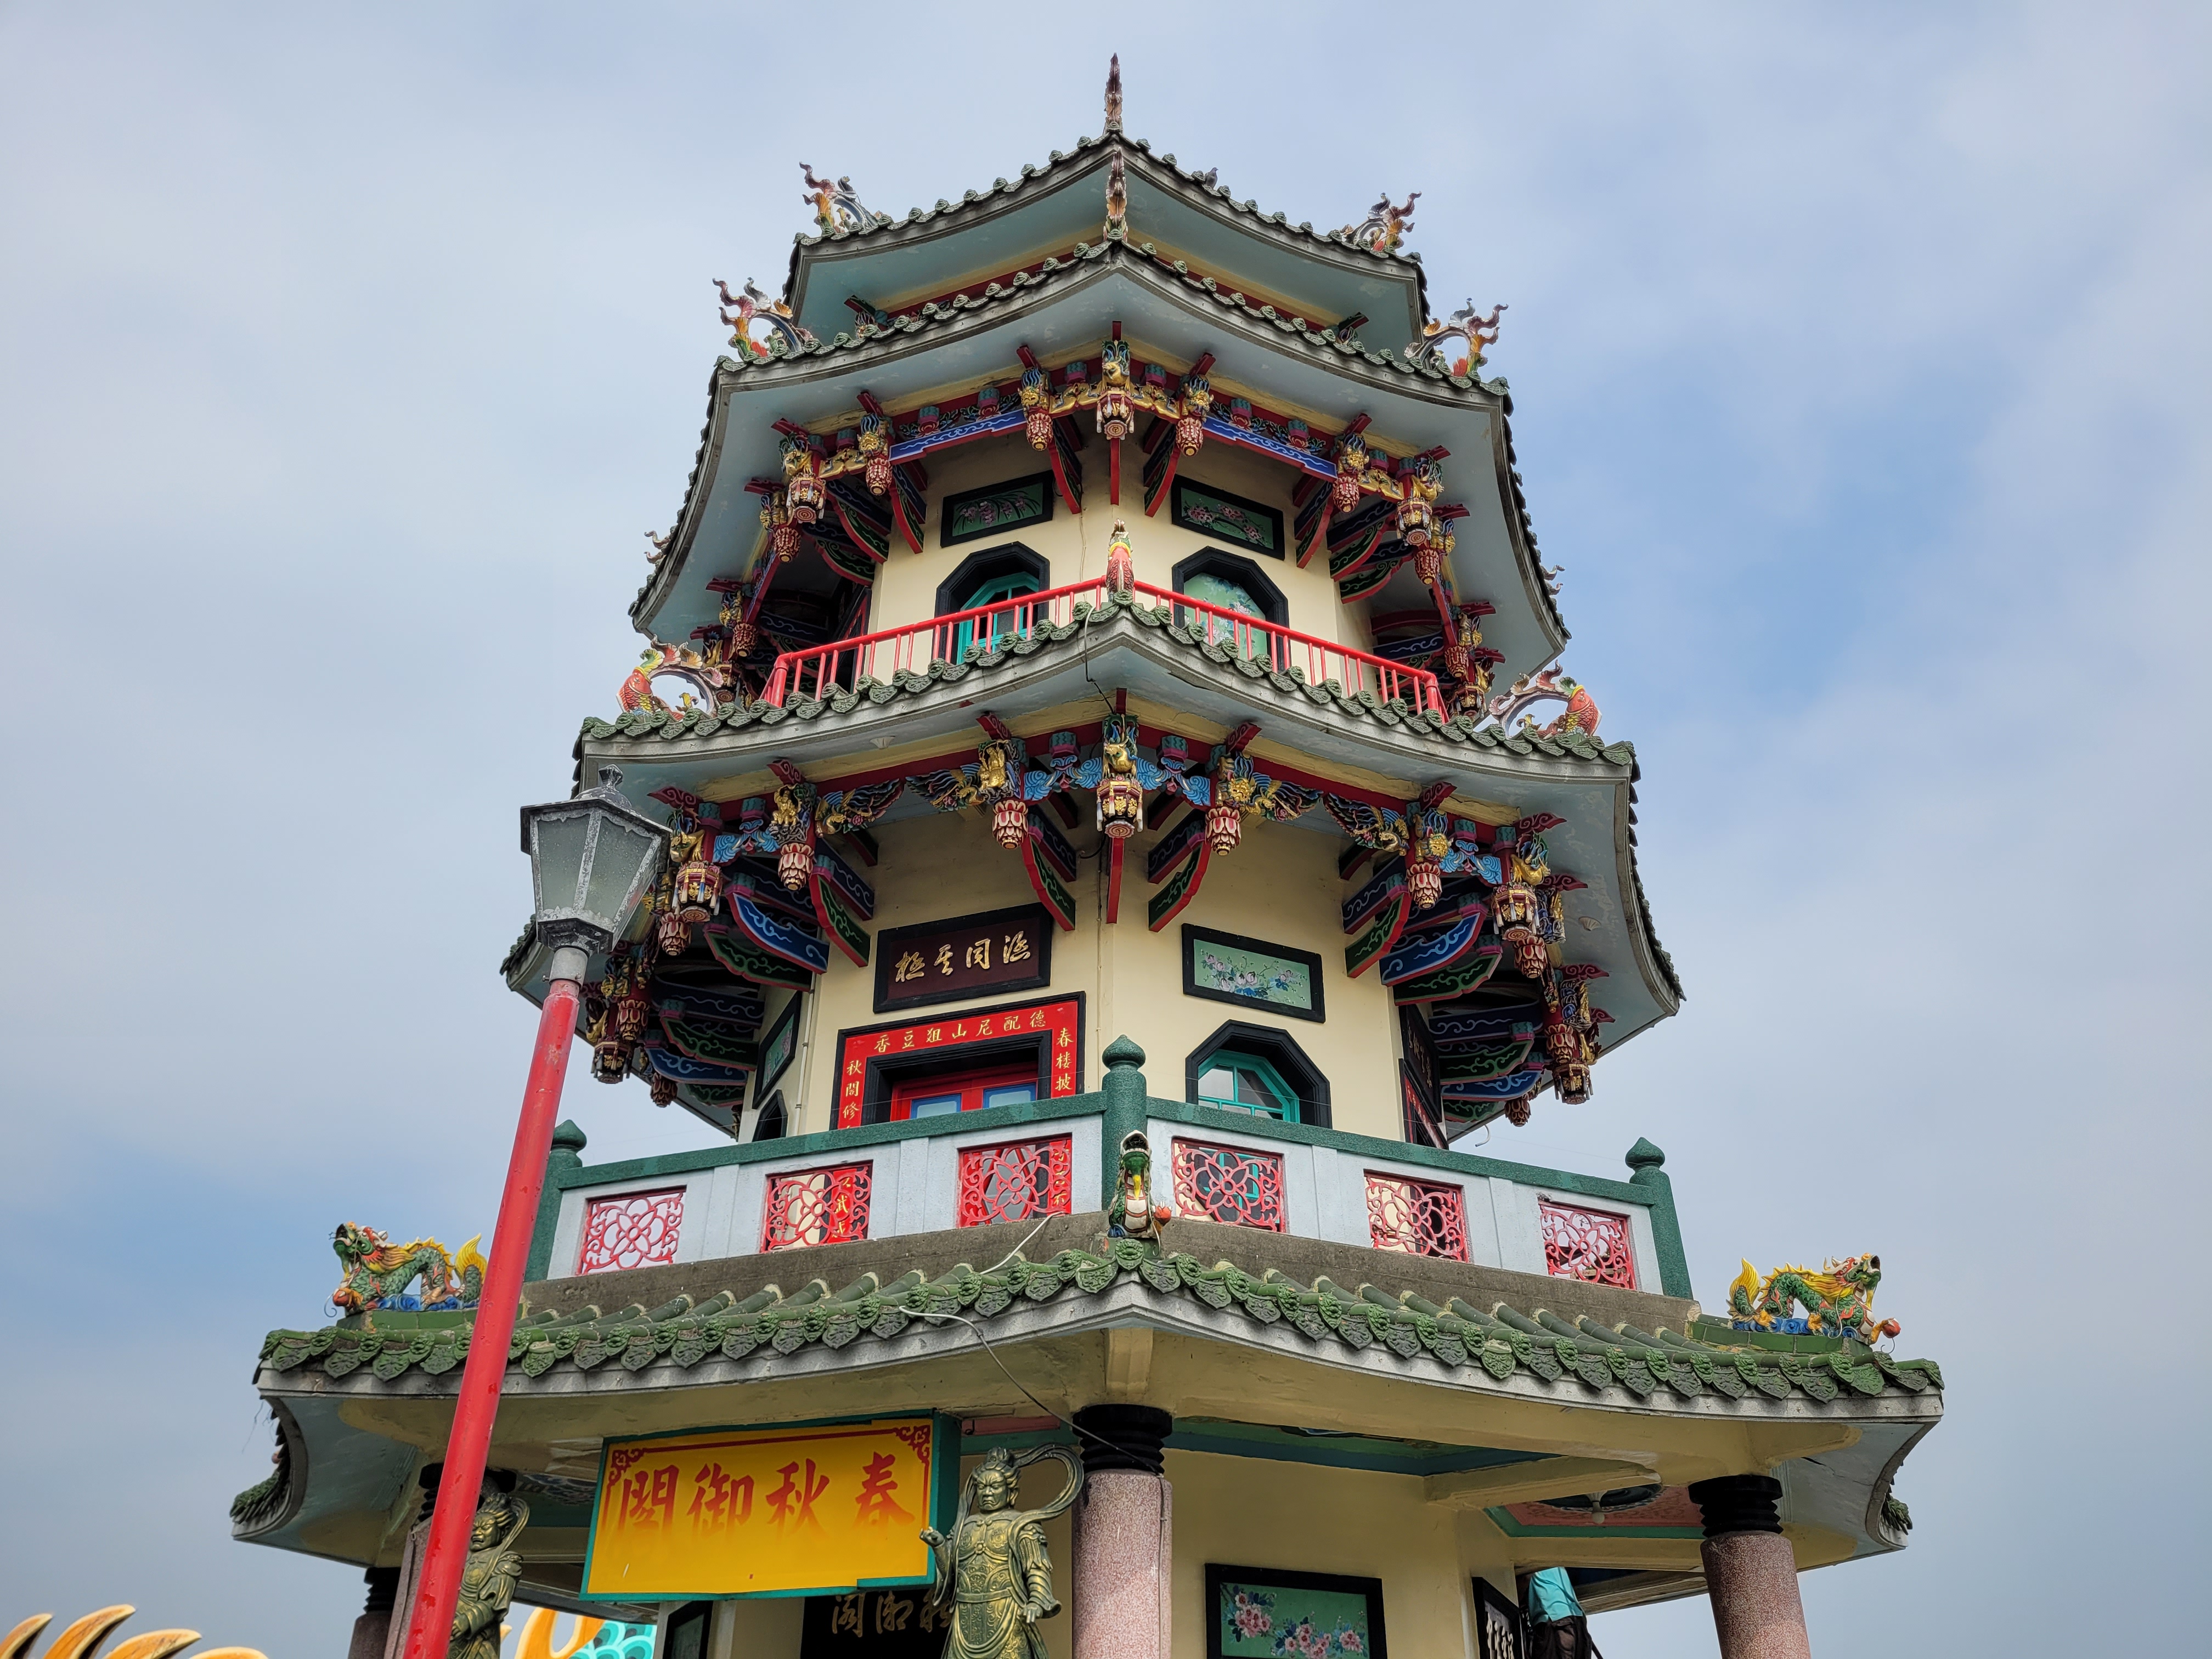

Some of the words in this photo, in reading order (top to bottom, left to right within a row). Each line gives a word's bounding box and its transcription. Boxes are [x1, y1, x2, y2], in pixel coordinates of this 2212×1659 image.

[842, 1059, 863, 1128] 秋閣修
[617, 1451, 916, 1538] 春秋御閣
